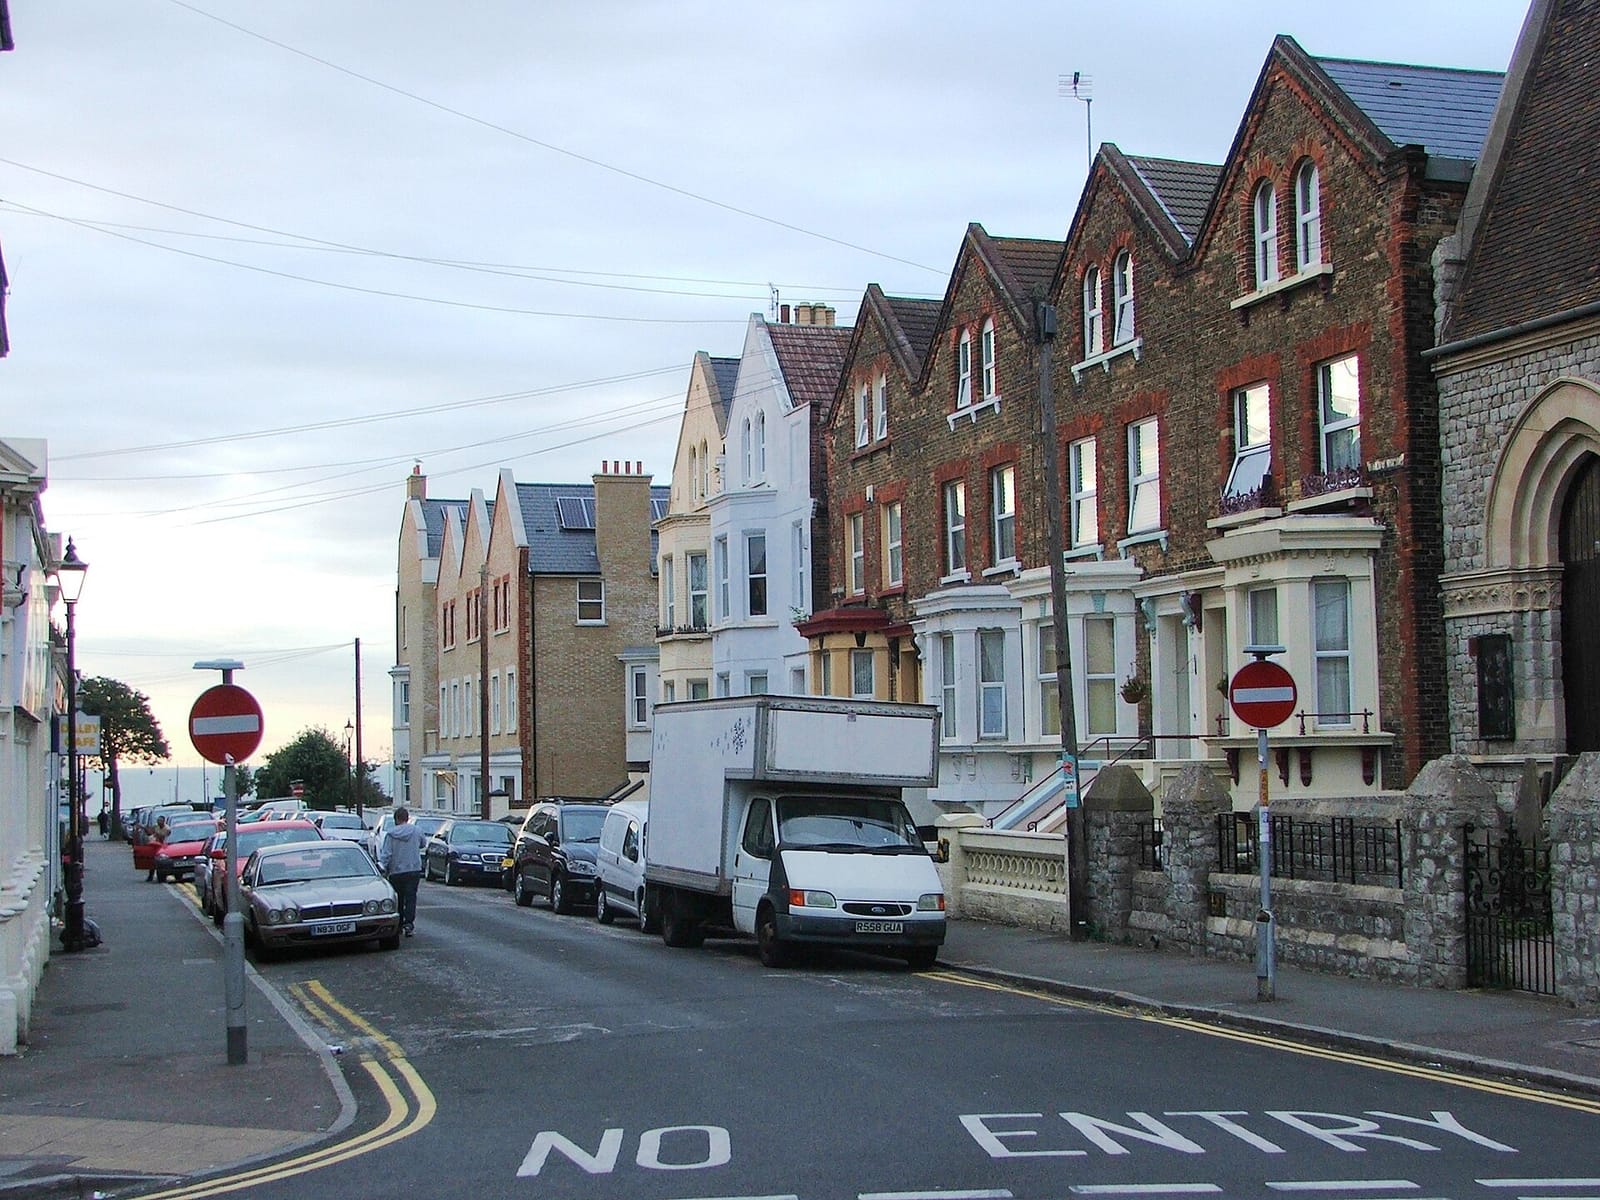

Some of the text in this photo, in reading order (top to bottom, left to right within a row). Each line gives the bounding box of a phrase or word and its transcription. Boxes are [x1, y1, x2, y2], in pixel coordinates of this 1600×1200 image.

[61, 723, 98, 733] DLBY
[857, 922, 902, 932] R558 GUA
[516, 1111, 1519, 1176] NO ENTRY
